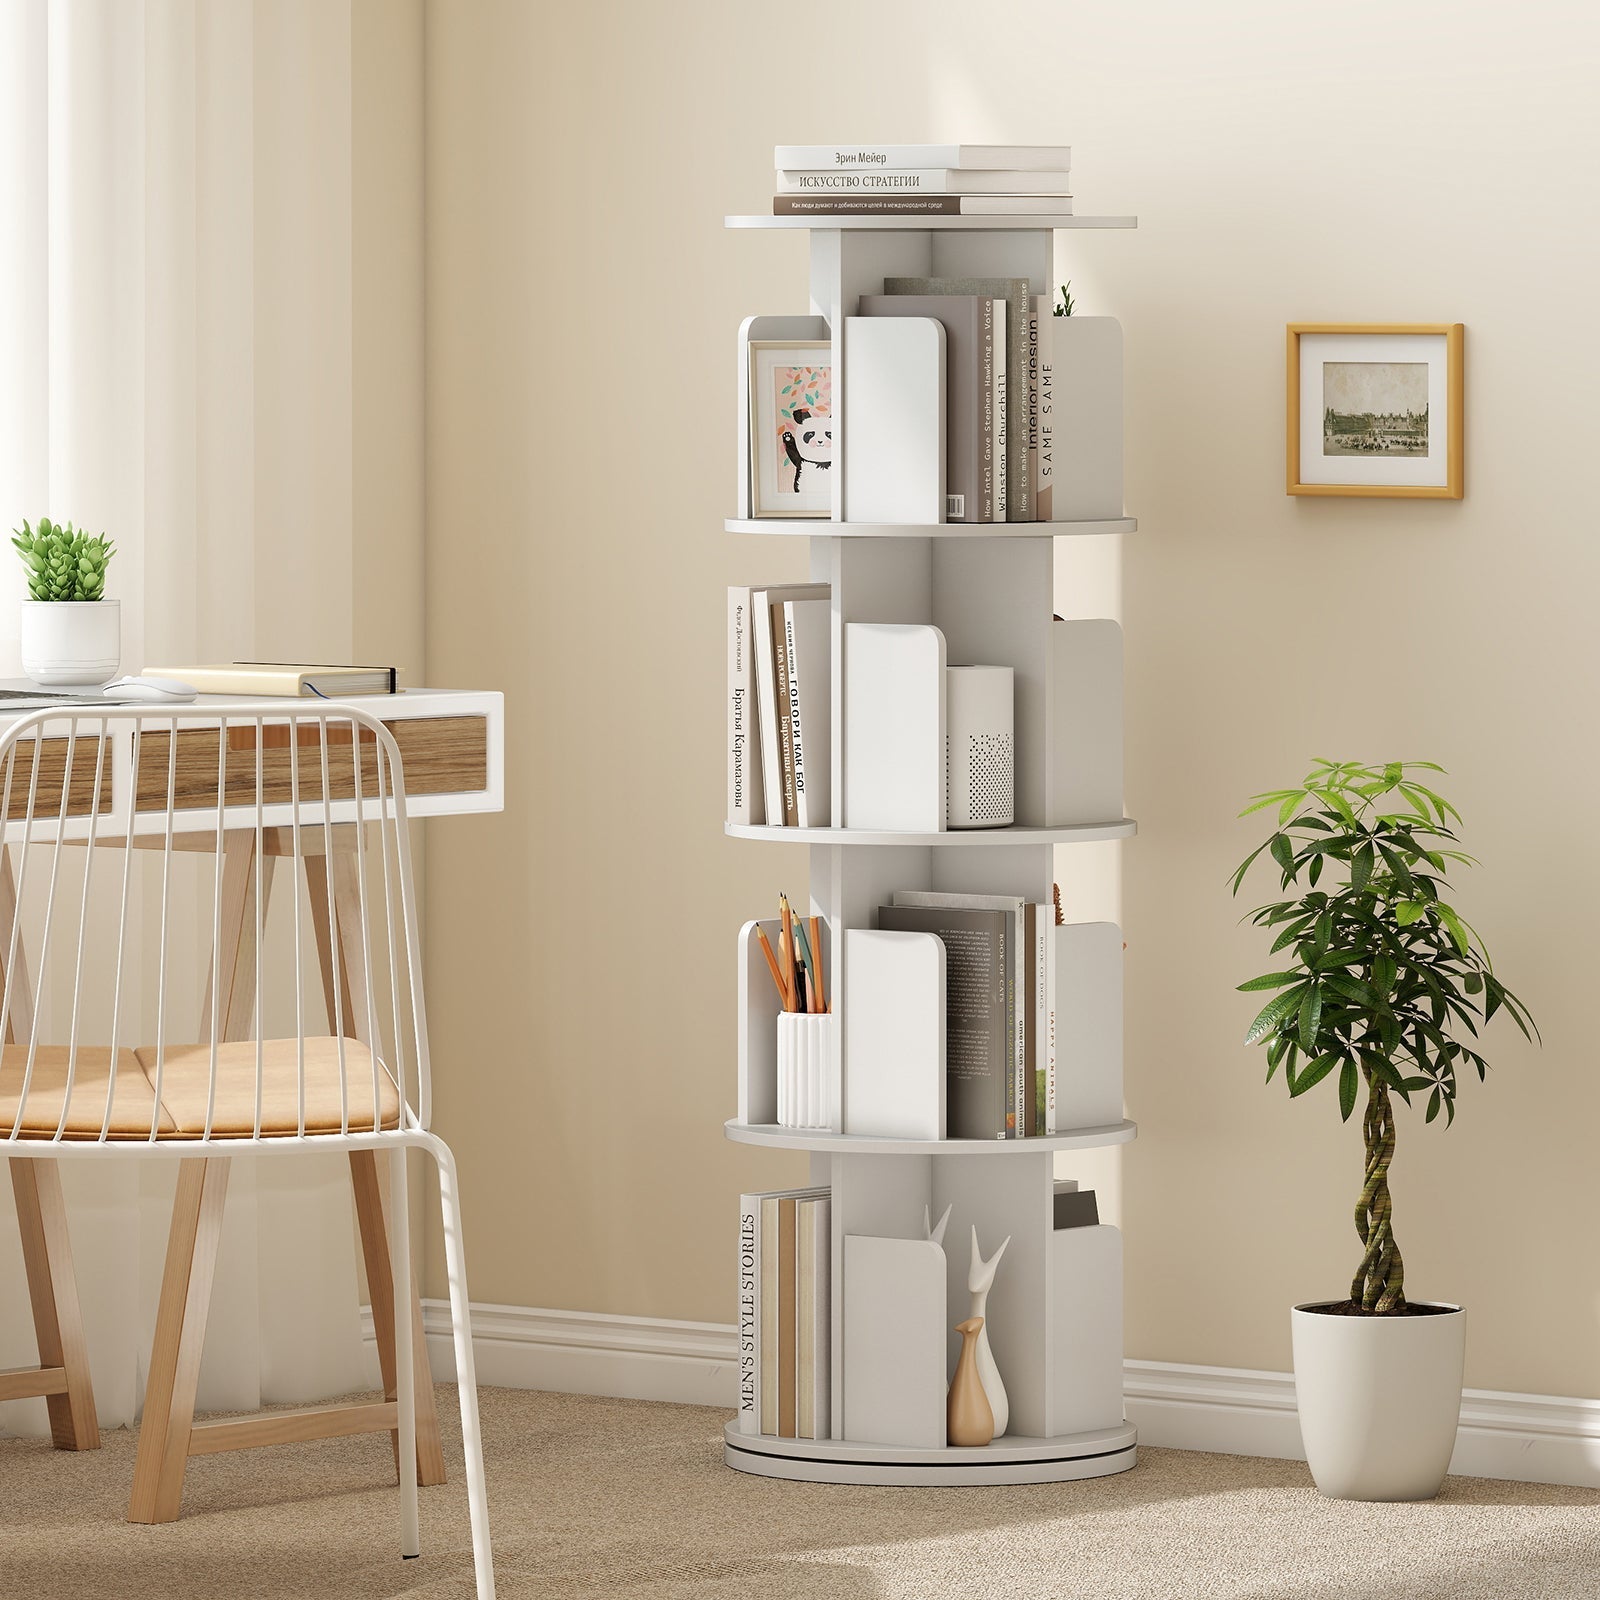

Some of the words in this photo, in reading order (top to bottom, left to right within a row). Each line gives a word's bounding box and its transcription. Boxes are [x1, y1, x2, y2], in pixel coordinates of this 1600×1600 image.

[836, 153, 856, 165] Эрин
[859, 153, 886, 165] Мейер
[799, 176, 859, 187] ИСКУССТВО
[863, 176, 920, 187] СТРАТЕГИИ
[838, 202, 867, 210] добиваются
[888, 202, 927, 210] международной
[984, 346, 992, 386] Hawking
[1021, 342, 1027, 352] in
[1029, 320, 1037, 379] design
[1043, 364, 1052, 413] SAME
[984, 392, 992, 431] Stephen
[998, 373, 1006, 445] Churchill
[1029, 387, 1037, 449] Interior
[1022, 430, 1027, 440] an
[1043, 426, 1052, 475] SAME
[998, 454, 1006, 511] Winston
[1021, 476, 1027, 487] to
[778, 665, 787, 697] РОБЕРТС
[733, 688, 745, 730] Братья
[790, 680, 801, 738] ГОВОРИ
[781, 715, 792, 771] Бархатная
[794, 744, 802, 766] КАК
[733, 734, 744, 808] Карамазовы
[796, 772, 804, 794] БОГ
[784, 774, 794, 810] смерть
[999, 964, 1004, 977] OF
[1008, 1015, 1013, 1027] OF
[742, 1214, 754, 1290] STORIES
[742, 1295, 754, 1351] STYLE
[742, 1356, 754, 1411] MEN'S
